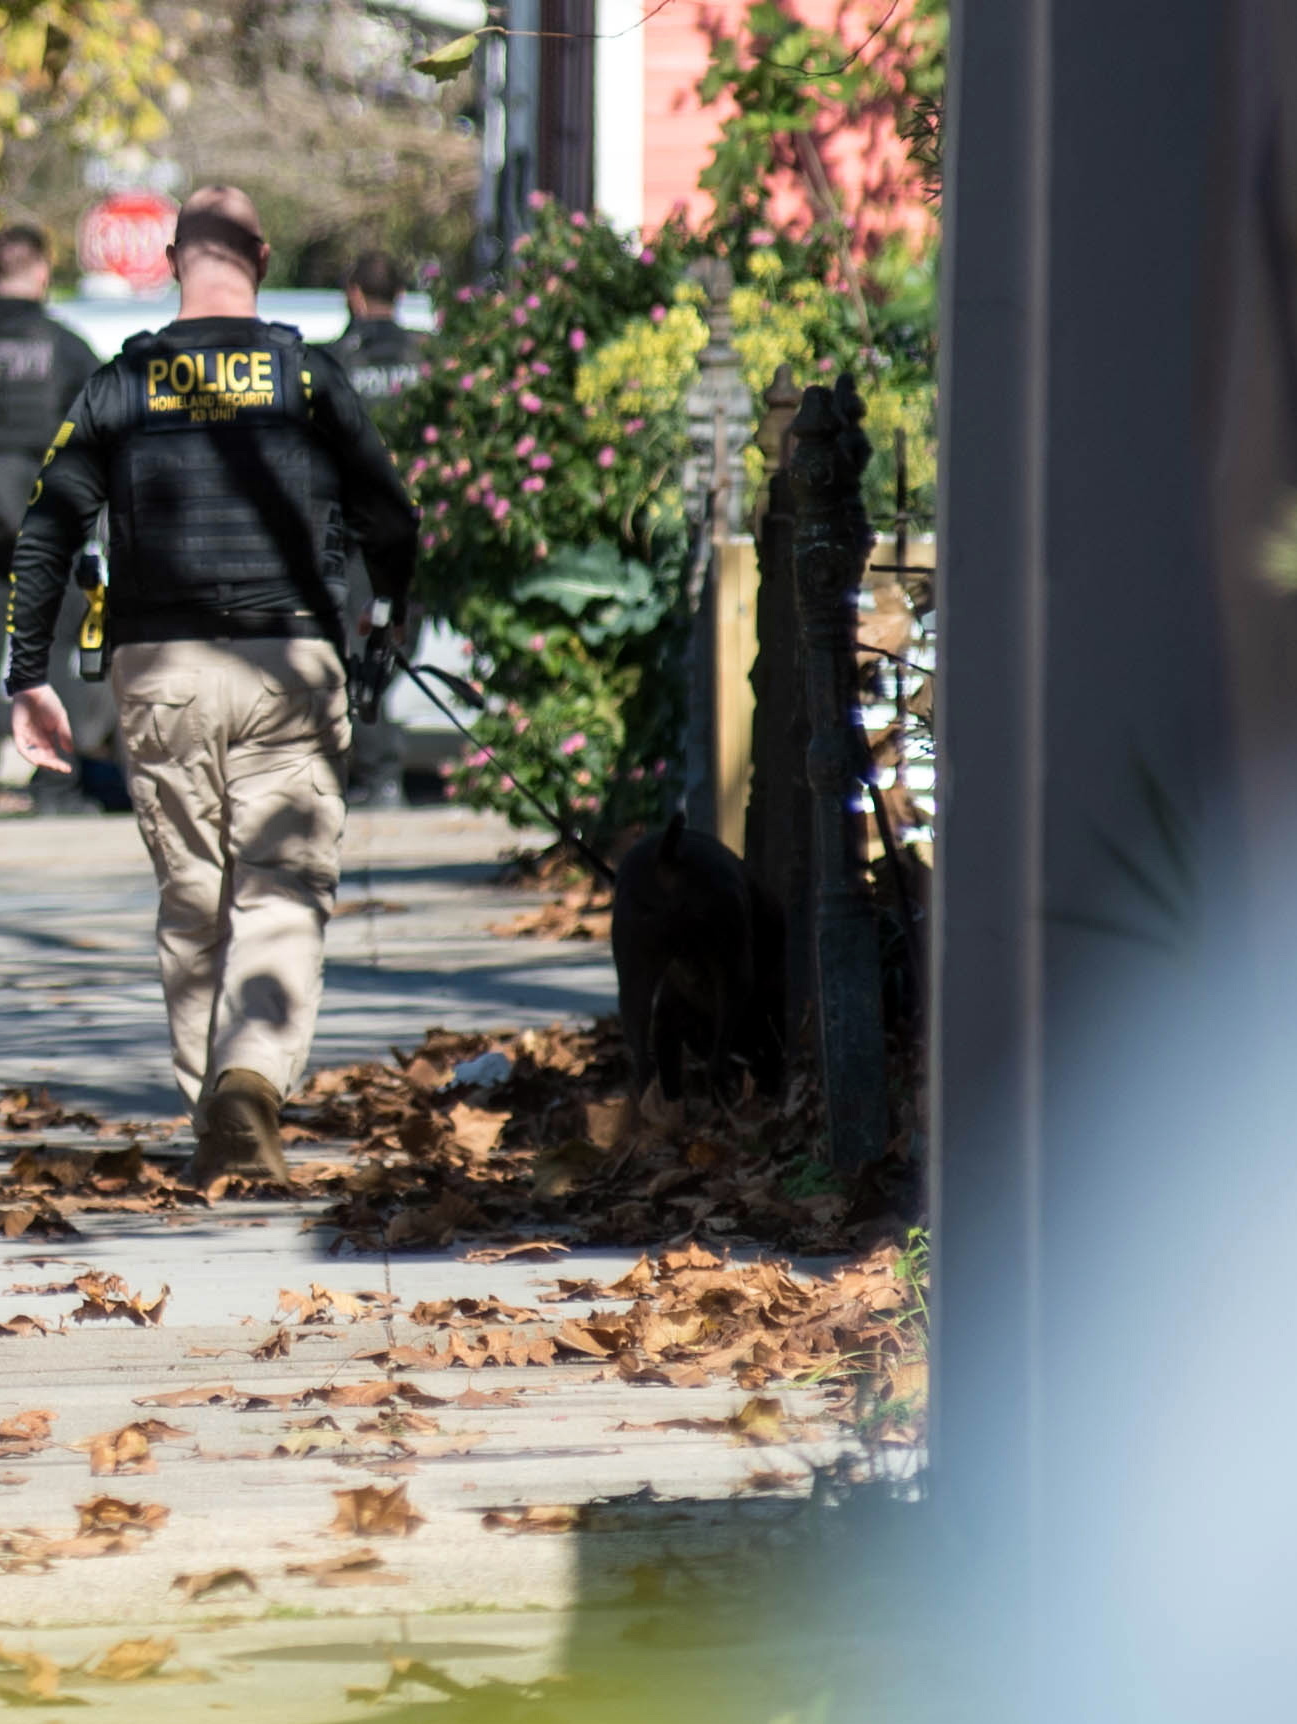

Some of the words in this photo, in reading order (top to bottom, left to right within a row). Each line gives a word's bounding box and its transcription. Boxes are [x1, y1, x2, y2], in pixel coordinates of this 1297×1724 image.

[147, 351, 274, 396] POLICE
[149, 392, 216, 412] HOMELAND
[217, 391, 275, 408] SECURITY
[210, 407, 238, 421] UNIT
